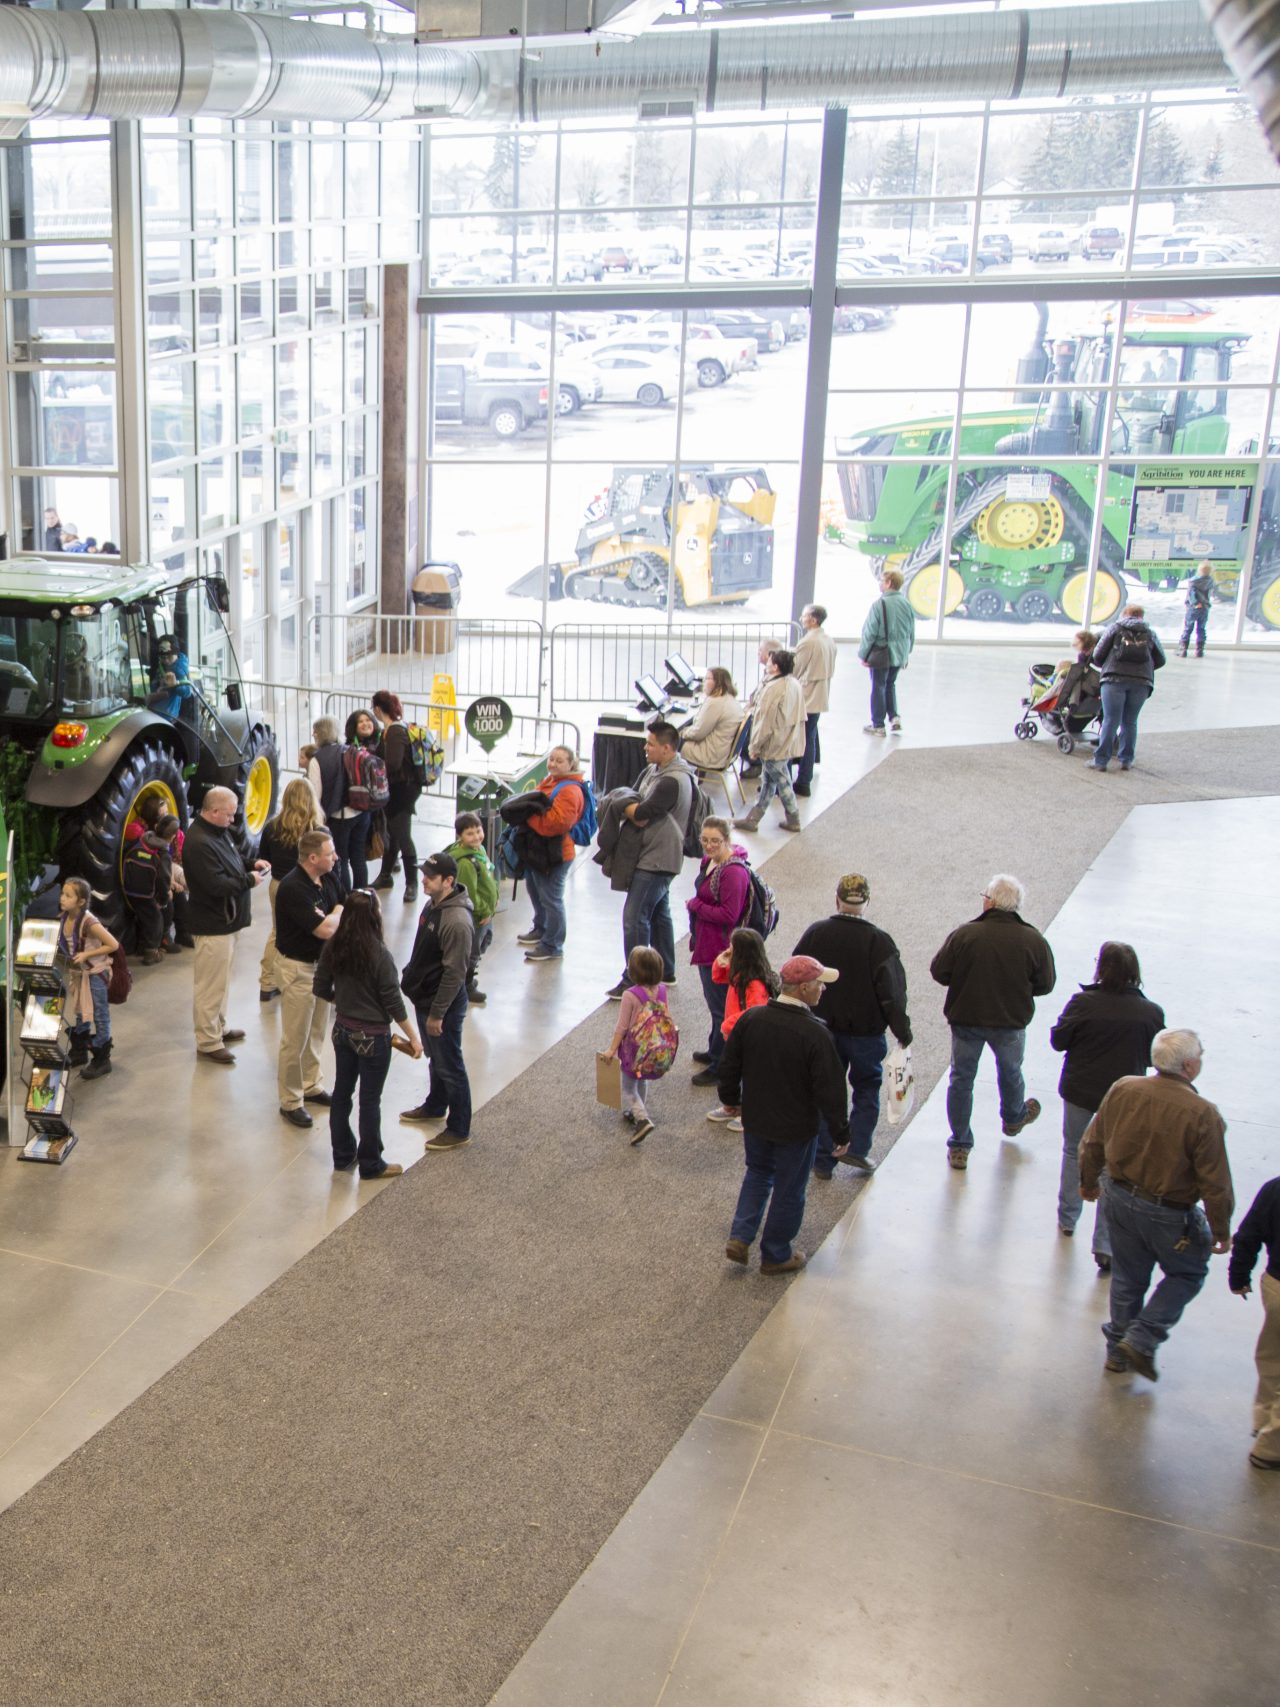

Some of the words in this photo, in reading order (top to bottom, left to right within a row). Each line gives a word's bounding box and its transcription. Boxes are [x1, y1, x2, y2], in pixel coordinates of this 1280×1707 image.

[1189, 469, 1205, 478] YOU
[1207, 469, 1223, 478] ARE
[1225, 469, 1246, 478] HERE
[476, 704, 501, 716] WIN
